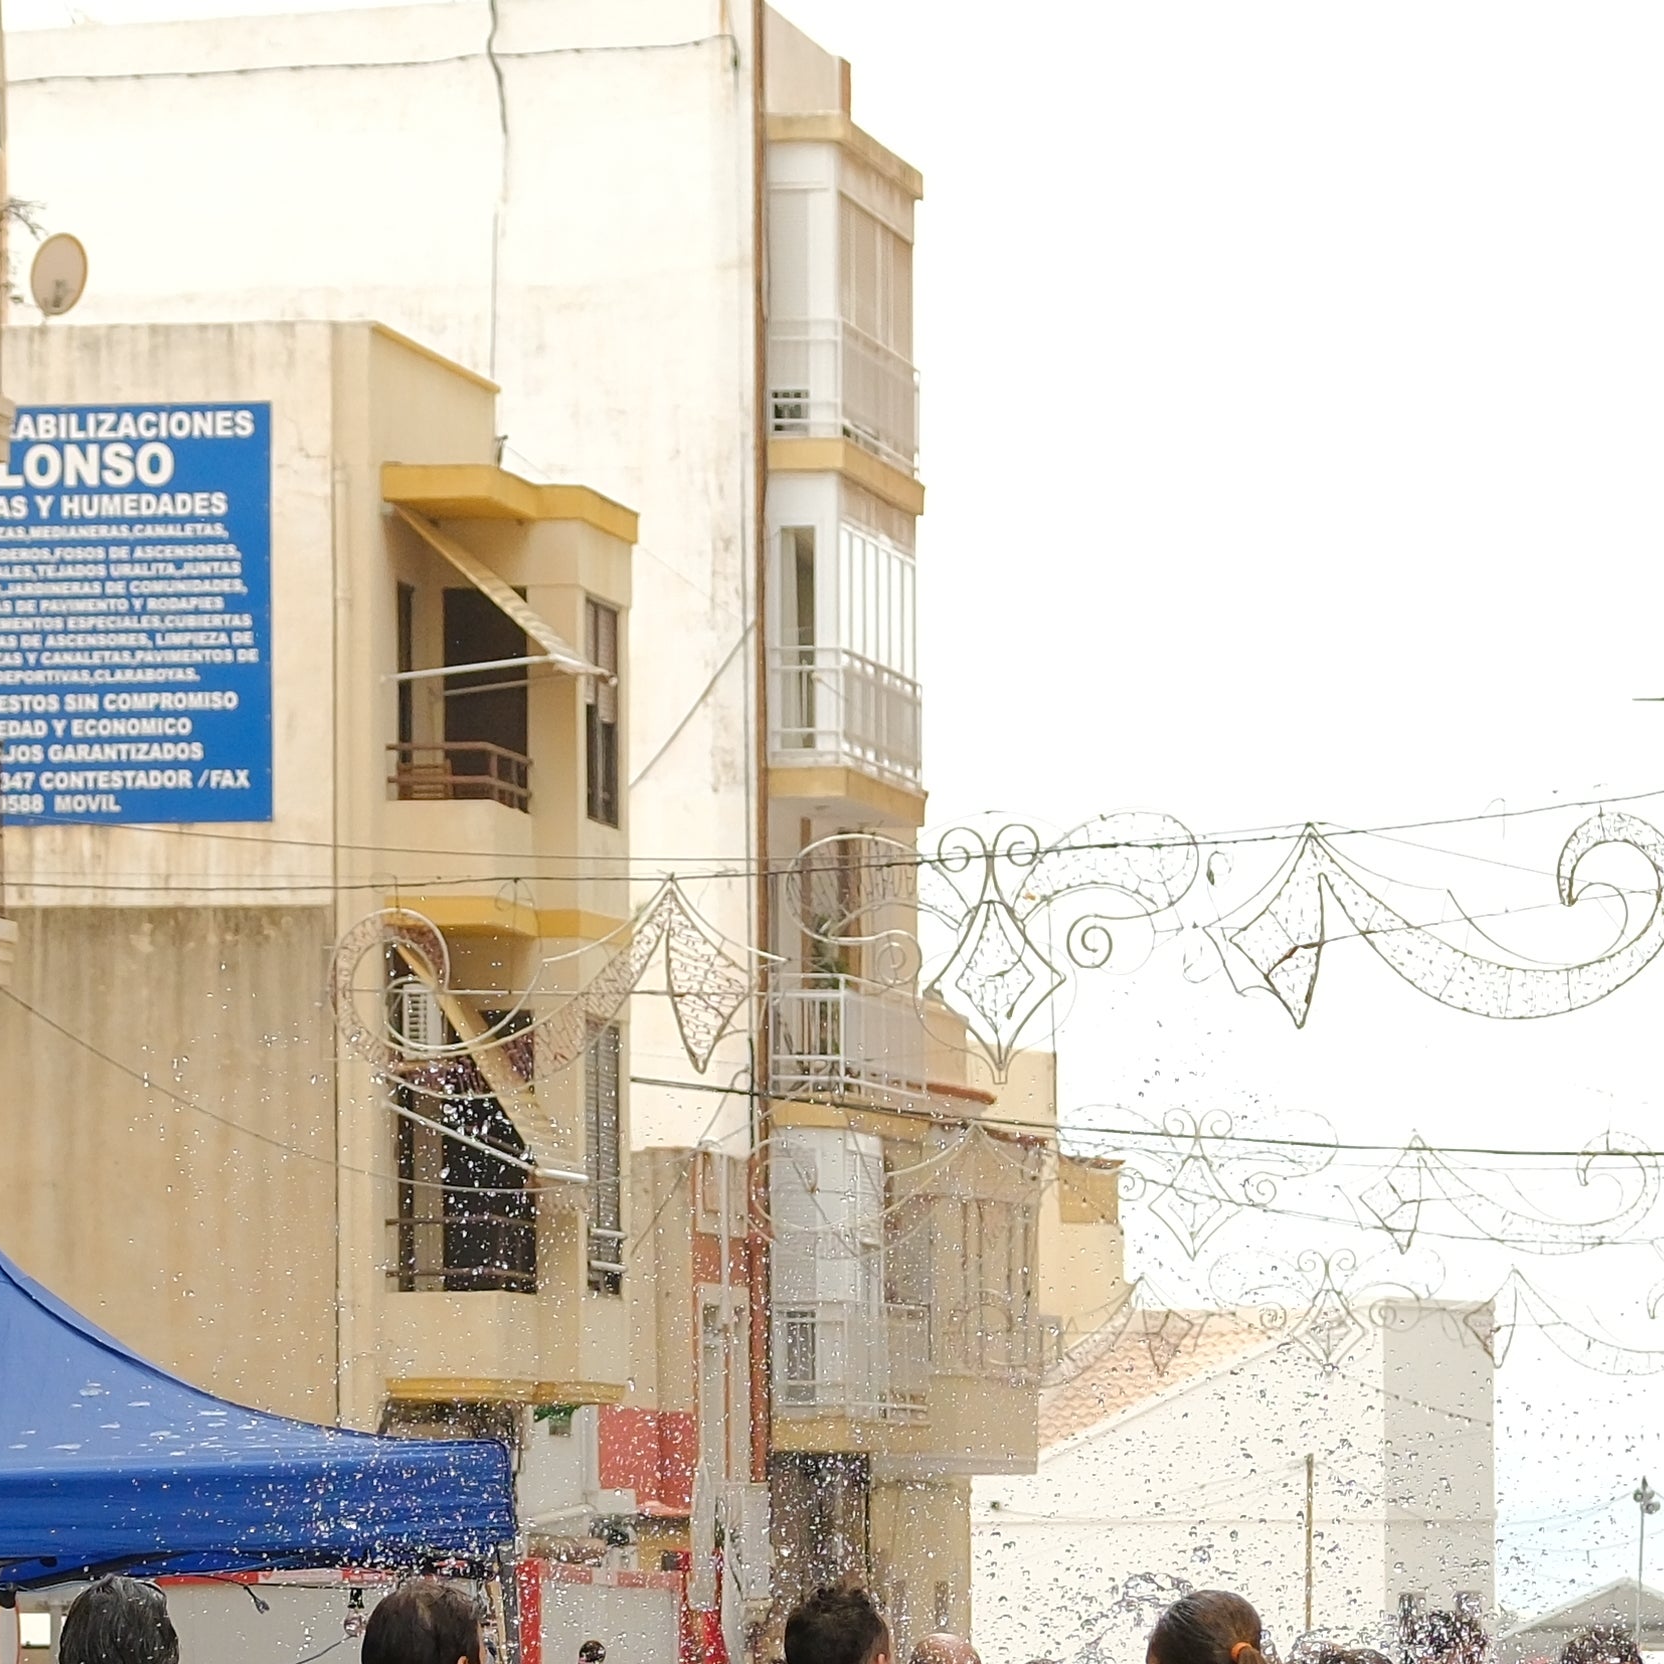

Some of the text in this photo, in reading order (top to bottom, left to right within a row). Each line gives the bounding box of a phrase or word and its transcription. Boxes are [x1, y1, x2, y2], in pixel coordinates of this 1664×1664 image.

[10, 409, 255, 441] ABILIZACIONES
[34, 495, 55, 519] Y
[61, 491, 228, 519] HUMEDADES
[108, 546, 131, 560] DE
[105, 581, 127, 596] DE
[131, 598, 145, 612] Y
[19, 634, 43, 649] DE
[231, 631, 254, 646] DE
[25, 652, 38, 667] Y
[236, 648, 259, 663] DE
[63, 693, 99, 713] SIN
[103, 690, 239, 712] COMPROMISO
[51, 719, 68, 738] Y
[71, 716, 193, 738] ECONOMICO
[47, 742, 205, 763] GARANTIZADOS
[39, 769, 193, 791] CONTESTADOR
[53, 793, 122, 813] MOVIL
